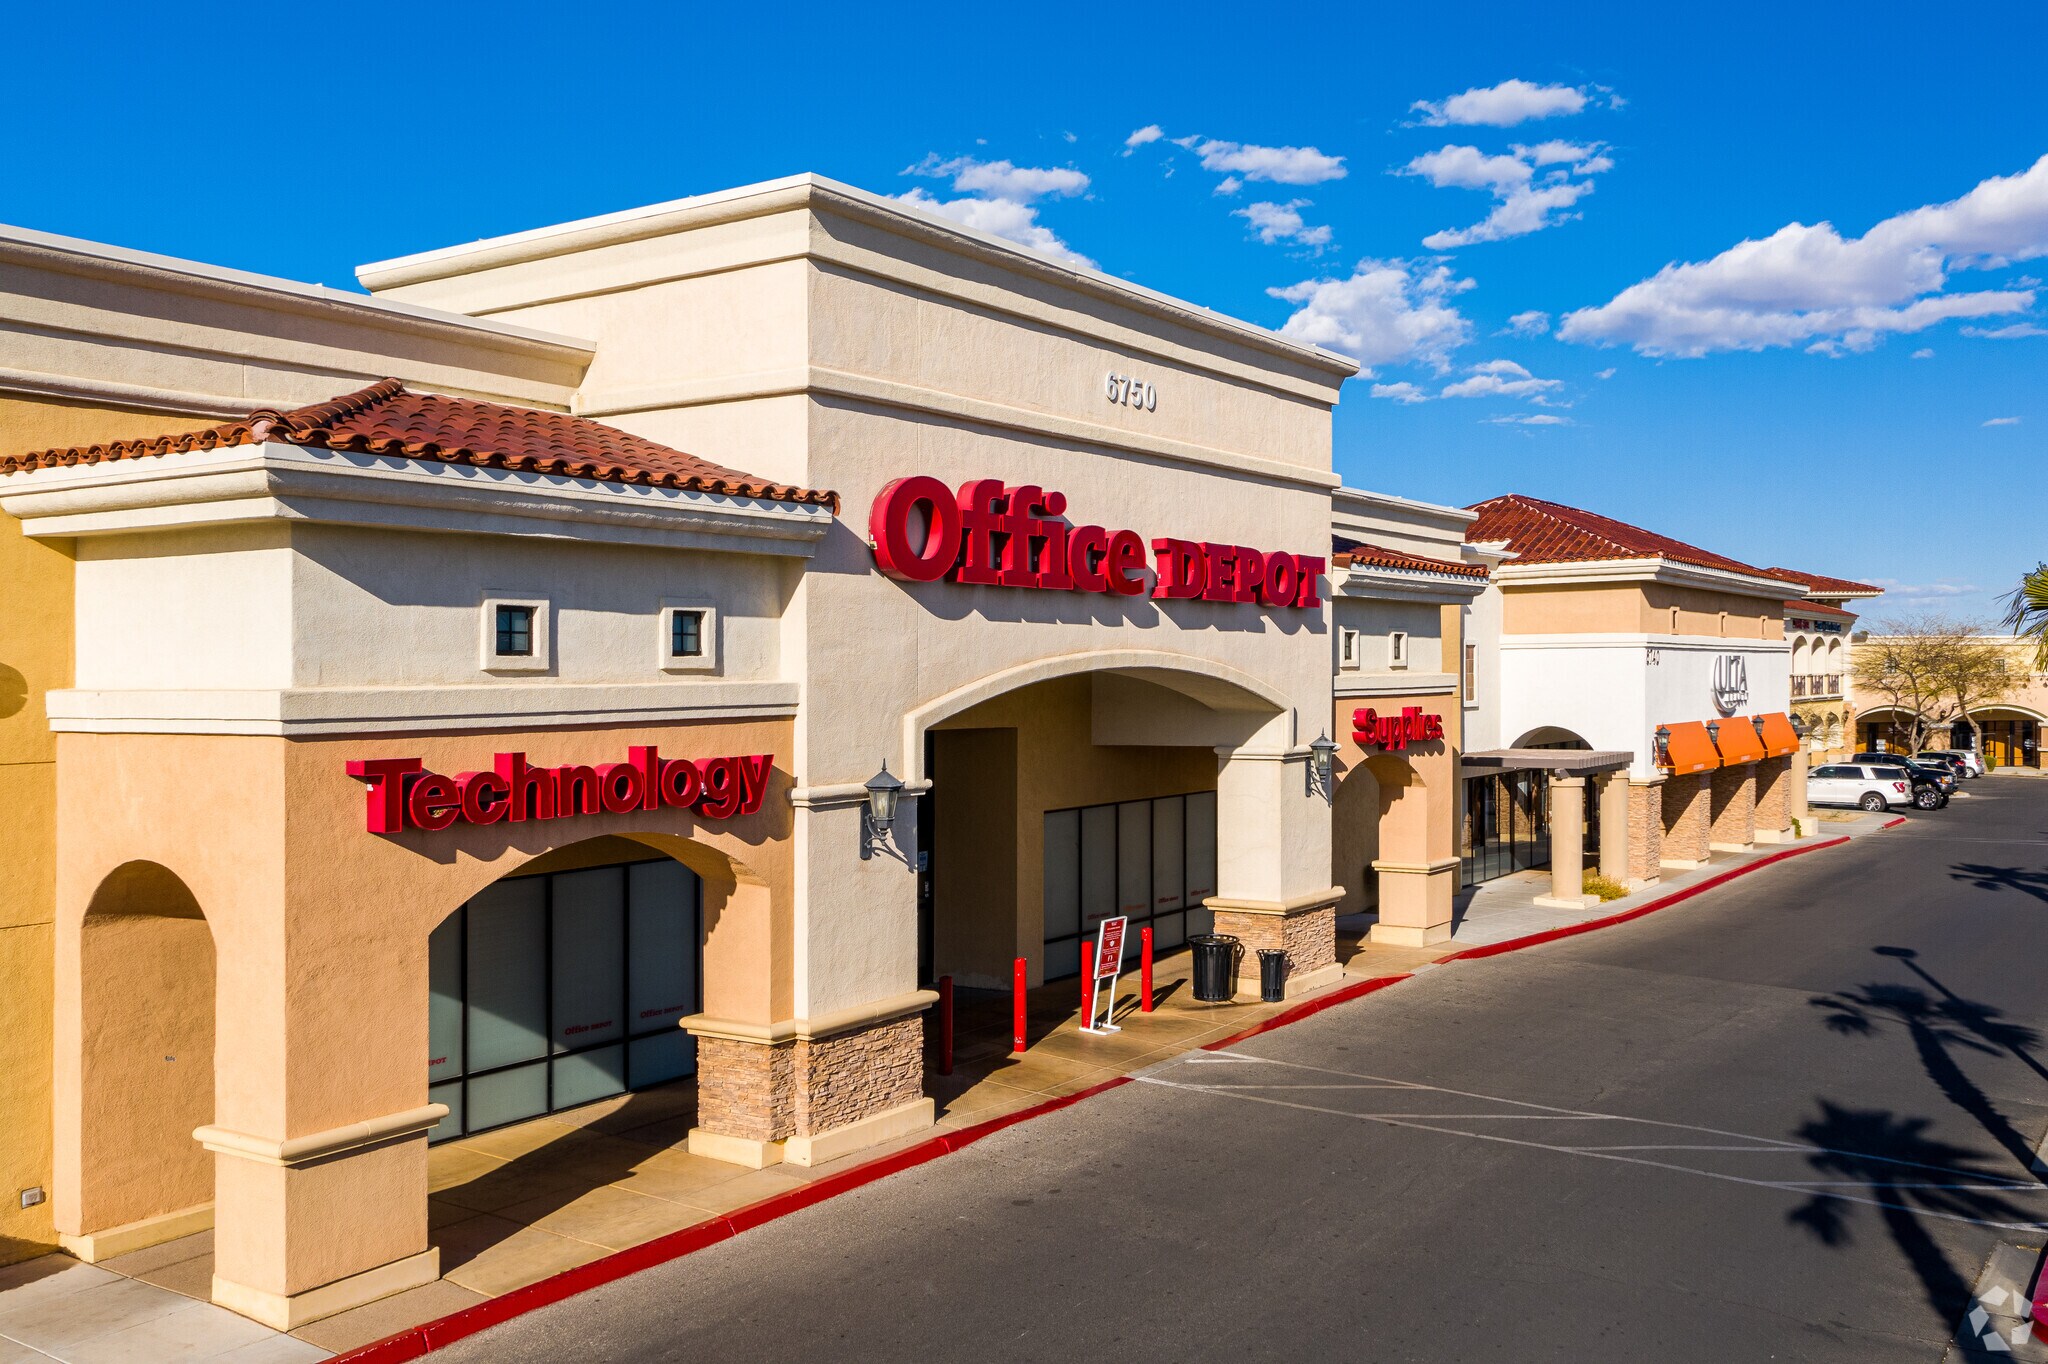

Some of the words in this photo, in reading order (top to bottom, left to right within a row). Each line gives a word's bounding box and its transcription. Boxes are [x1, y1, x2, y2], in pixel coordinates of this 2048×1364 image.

[1105, 371, 1156, 410] 6750
[869, 476, 1146, 596] Office
[1151, 538, 1325, 608] DEPOT
[1716, 655, 1747, 690] ULTA
[1352, 706, 1445, 751] Supplies
[346, 746, 774, 833] Technology
[564, 1023, 590, 1036] Office
[429, 1056, 447, 1067] POT
